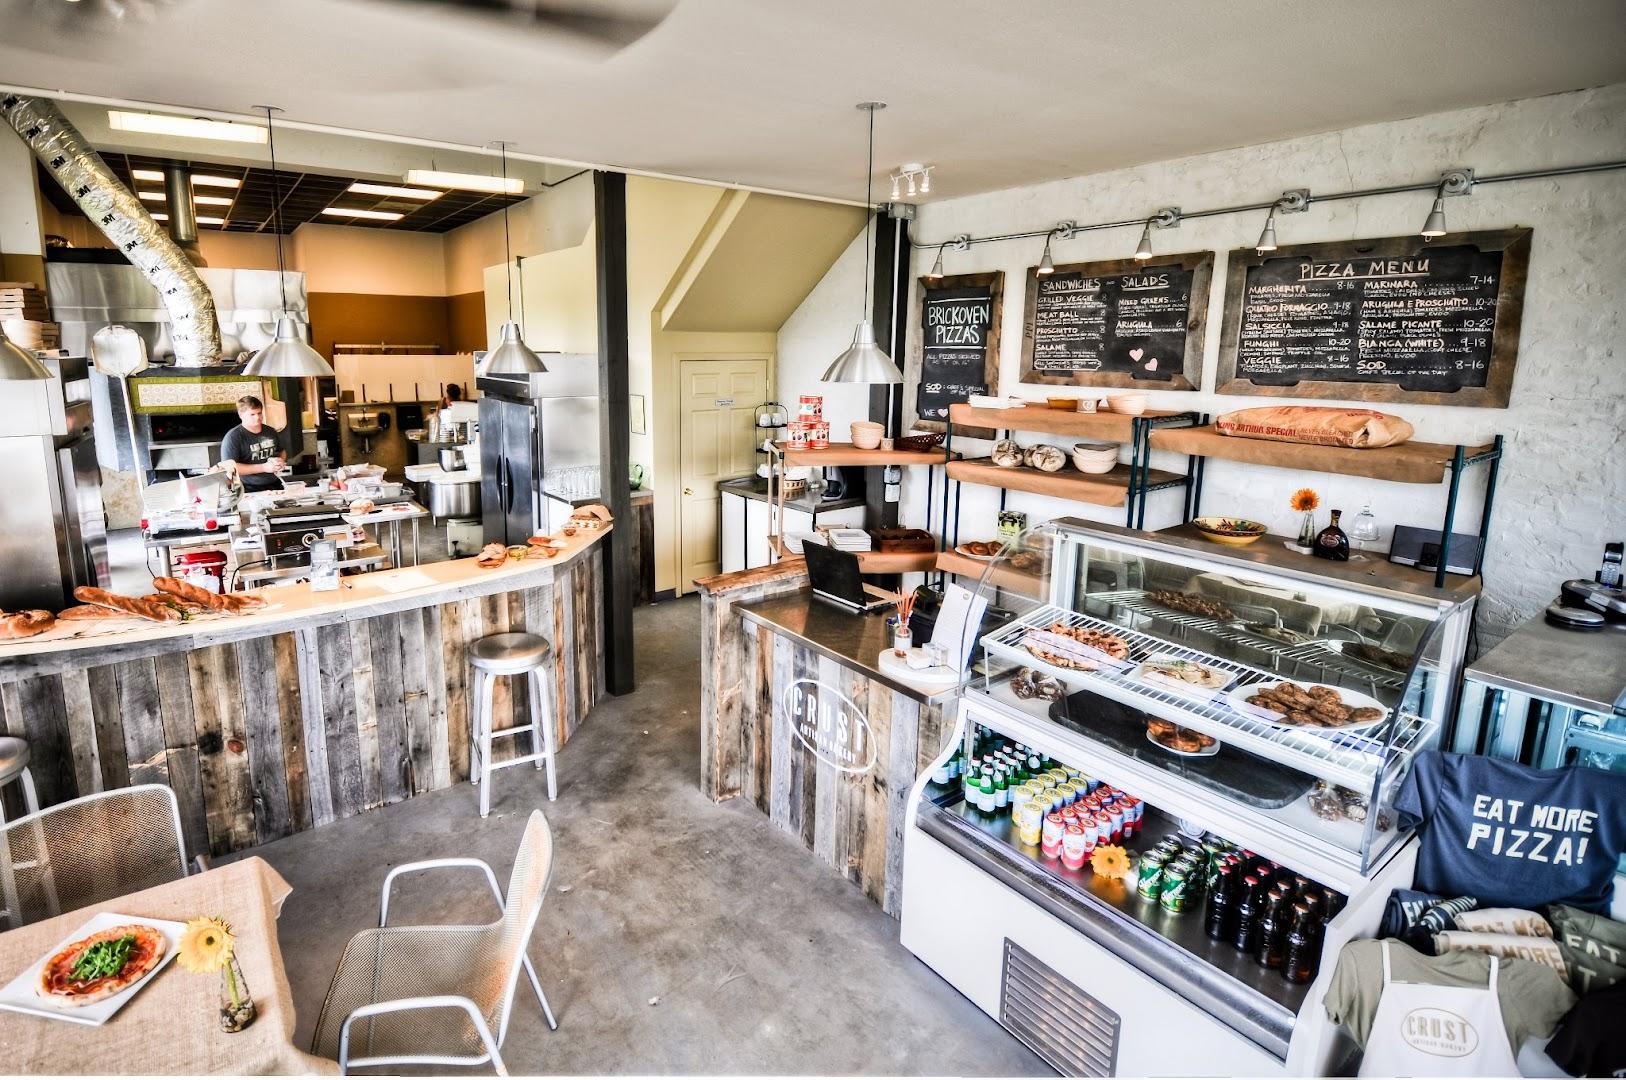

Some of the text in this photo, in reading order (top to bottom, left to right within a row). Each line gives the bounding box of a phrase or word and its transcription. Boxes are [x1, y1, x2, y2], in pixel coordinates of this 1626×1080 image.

[26, 126, 42, 139] 3M
[50, 156, 66, 169] 3M
[76, 185, 91, 197] 3M
[101, 213, 116, 226] 3M
[125, 240, 138, 252] 3M
[1300, 259, 1430, 279] PIZZA MENU
[1041, 278, 1101, 292] SANDWICHES
[1121, 274, 1169, 288] SALADS
[1364, 275, 1495, 290] MARINARA 7-14
[1249, 284, 1307, 294] MARGHERITA
[1066, 294, 1094, 303] VEGGIE
[1181, 293, 1188, 301] 6
[1362, 300, 1404, 309] ARUGULA
[1415, 297, 1469, 308] PROSCIUTTO
[1475, 298, 1498, 306] 10-20
[928, 303, 990, 326] BRICKOVEN
[1099, 325, 1106, 334] 8
[1115, 320, 1153, 329] ARUGULA
[1175, 319, 1183, 328] 6
[1359, 318, 1494, 329] SALAME PICANTE 10-20
[935, 325, 980, 344] PIZZAS
[1099, 342, 1105, 351] 8
[1244, 338, 1352, 348] FUNGHI 10-20
[1358, 337, 1487, 349] BIANCA (WHITE) 9-18
[1454, 360, 1485, 370] 8-16
[923, 408, 936, 417] WE
[1236, 423, 1264, 434] ARTHUR
[1266, 426, 1297, 437] SPECIAL
[793, 686, 865, 752] CRUST
[1472, 794, 1599, 833] EAT MORE
[1466, 822, 1589, 866] PIZZA!
[1566, 933, 1621, 964] EAT
[1407, 1015, 1468, 1044] CRUST
